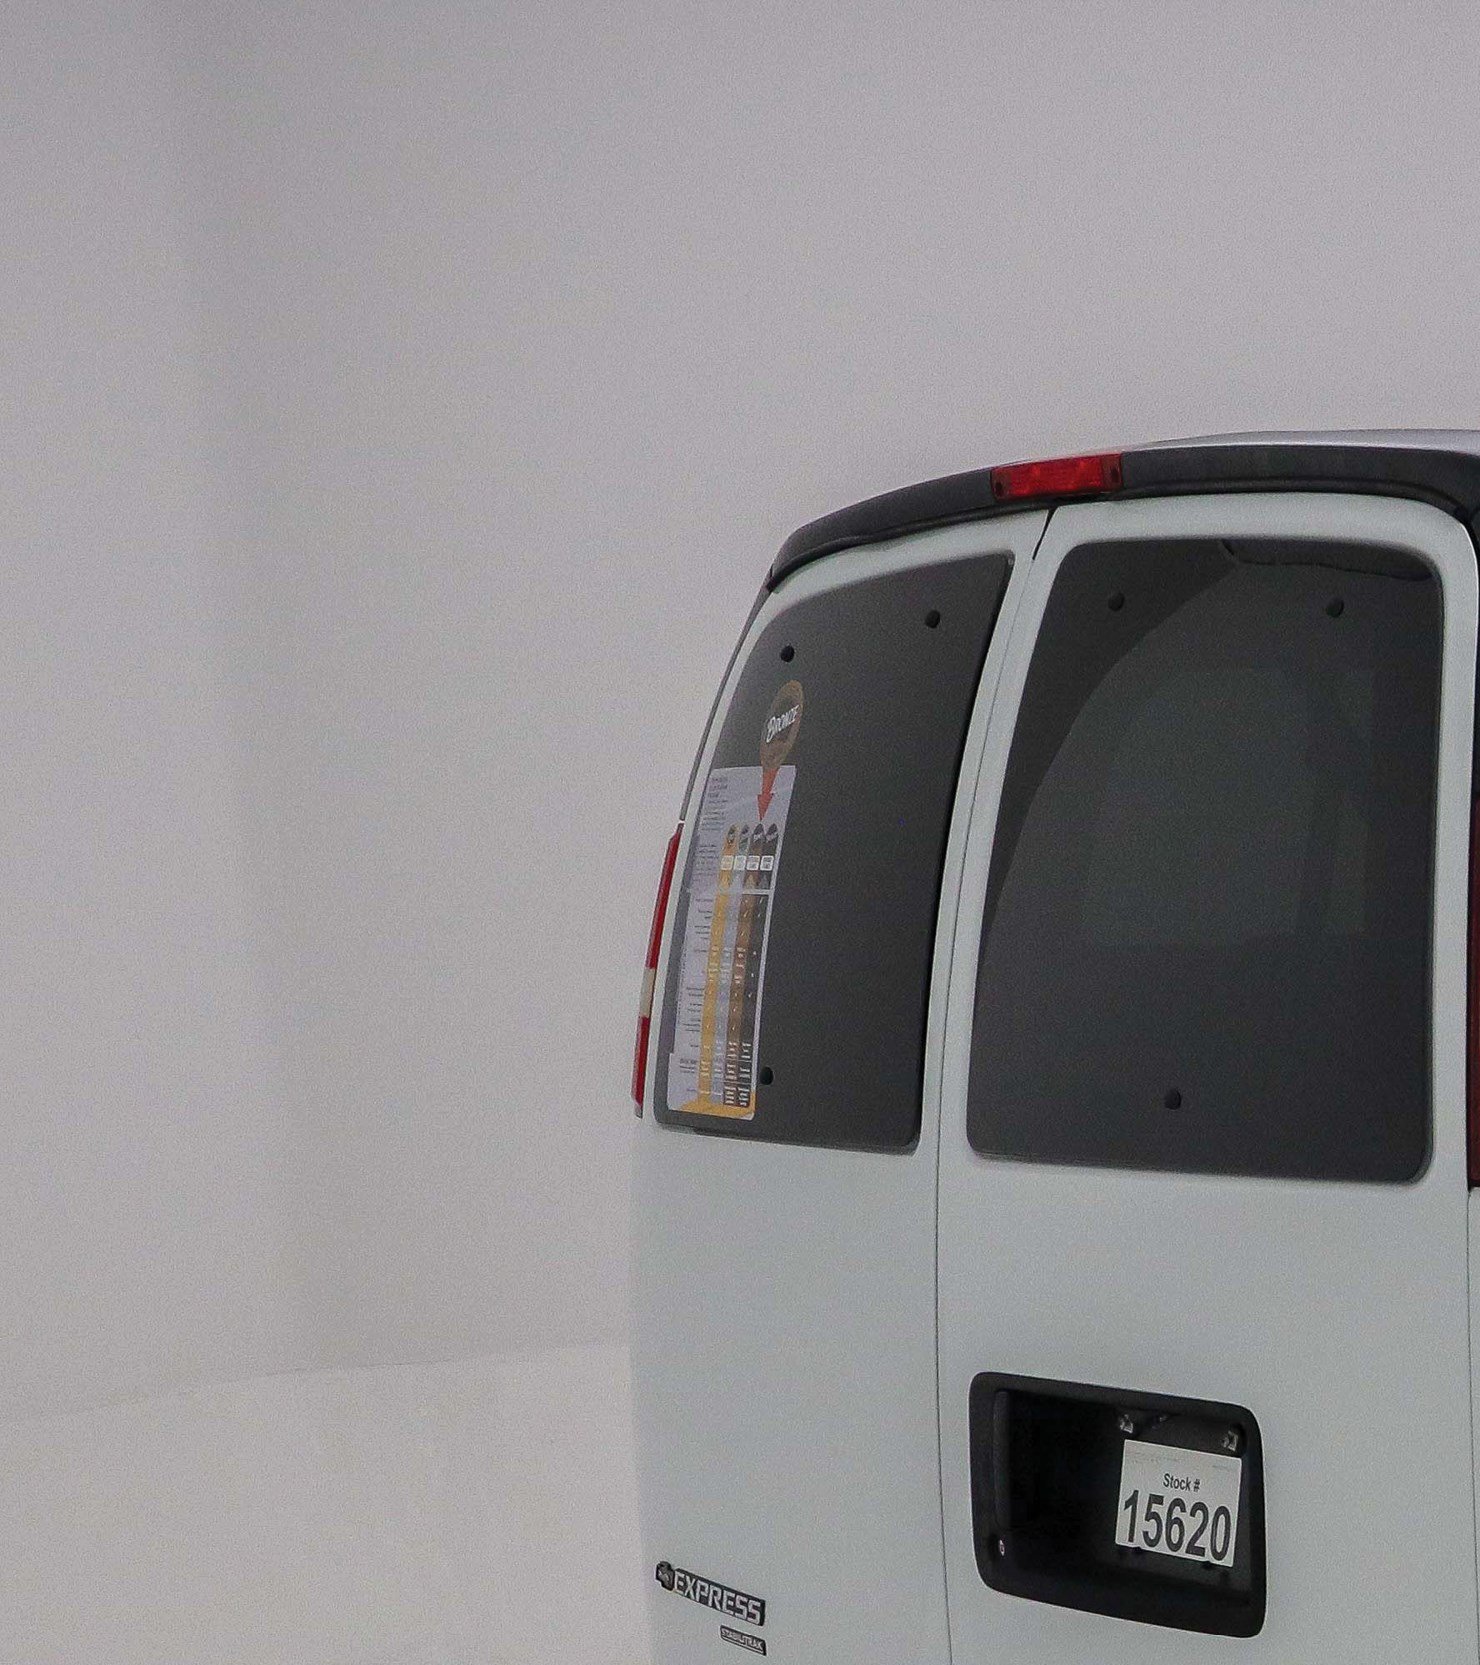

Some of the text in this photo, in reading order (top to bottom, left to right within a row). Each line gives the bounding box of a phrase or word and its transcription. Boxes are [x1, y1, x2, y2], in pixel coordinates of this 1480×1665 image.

[1162, 1473, 1192, 1491] Stock
[1122, 1489, 1232, 1562] 15620
[673, 1570, 762, 1626] EXPRESS
